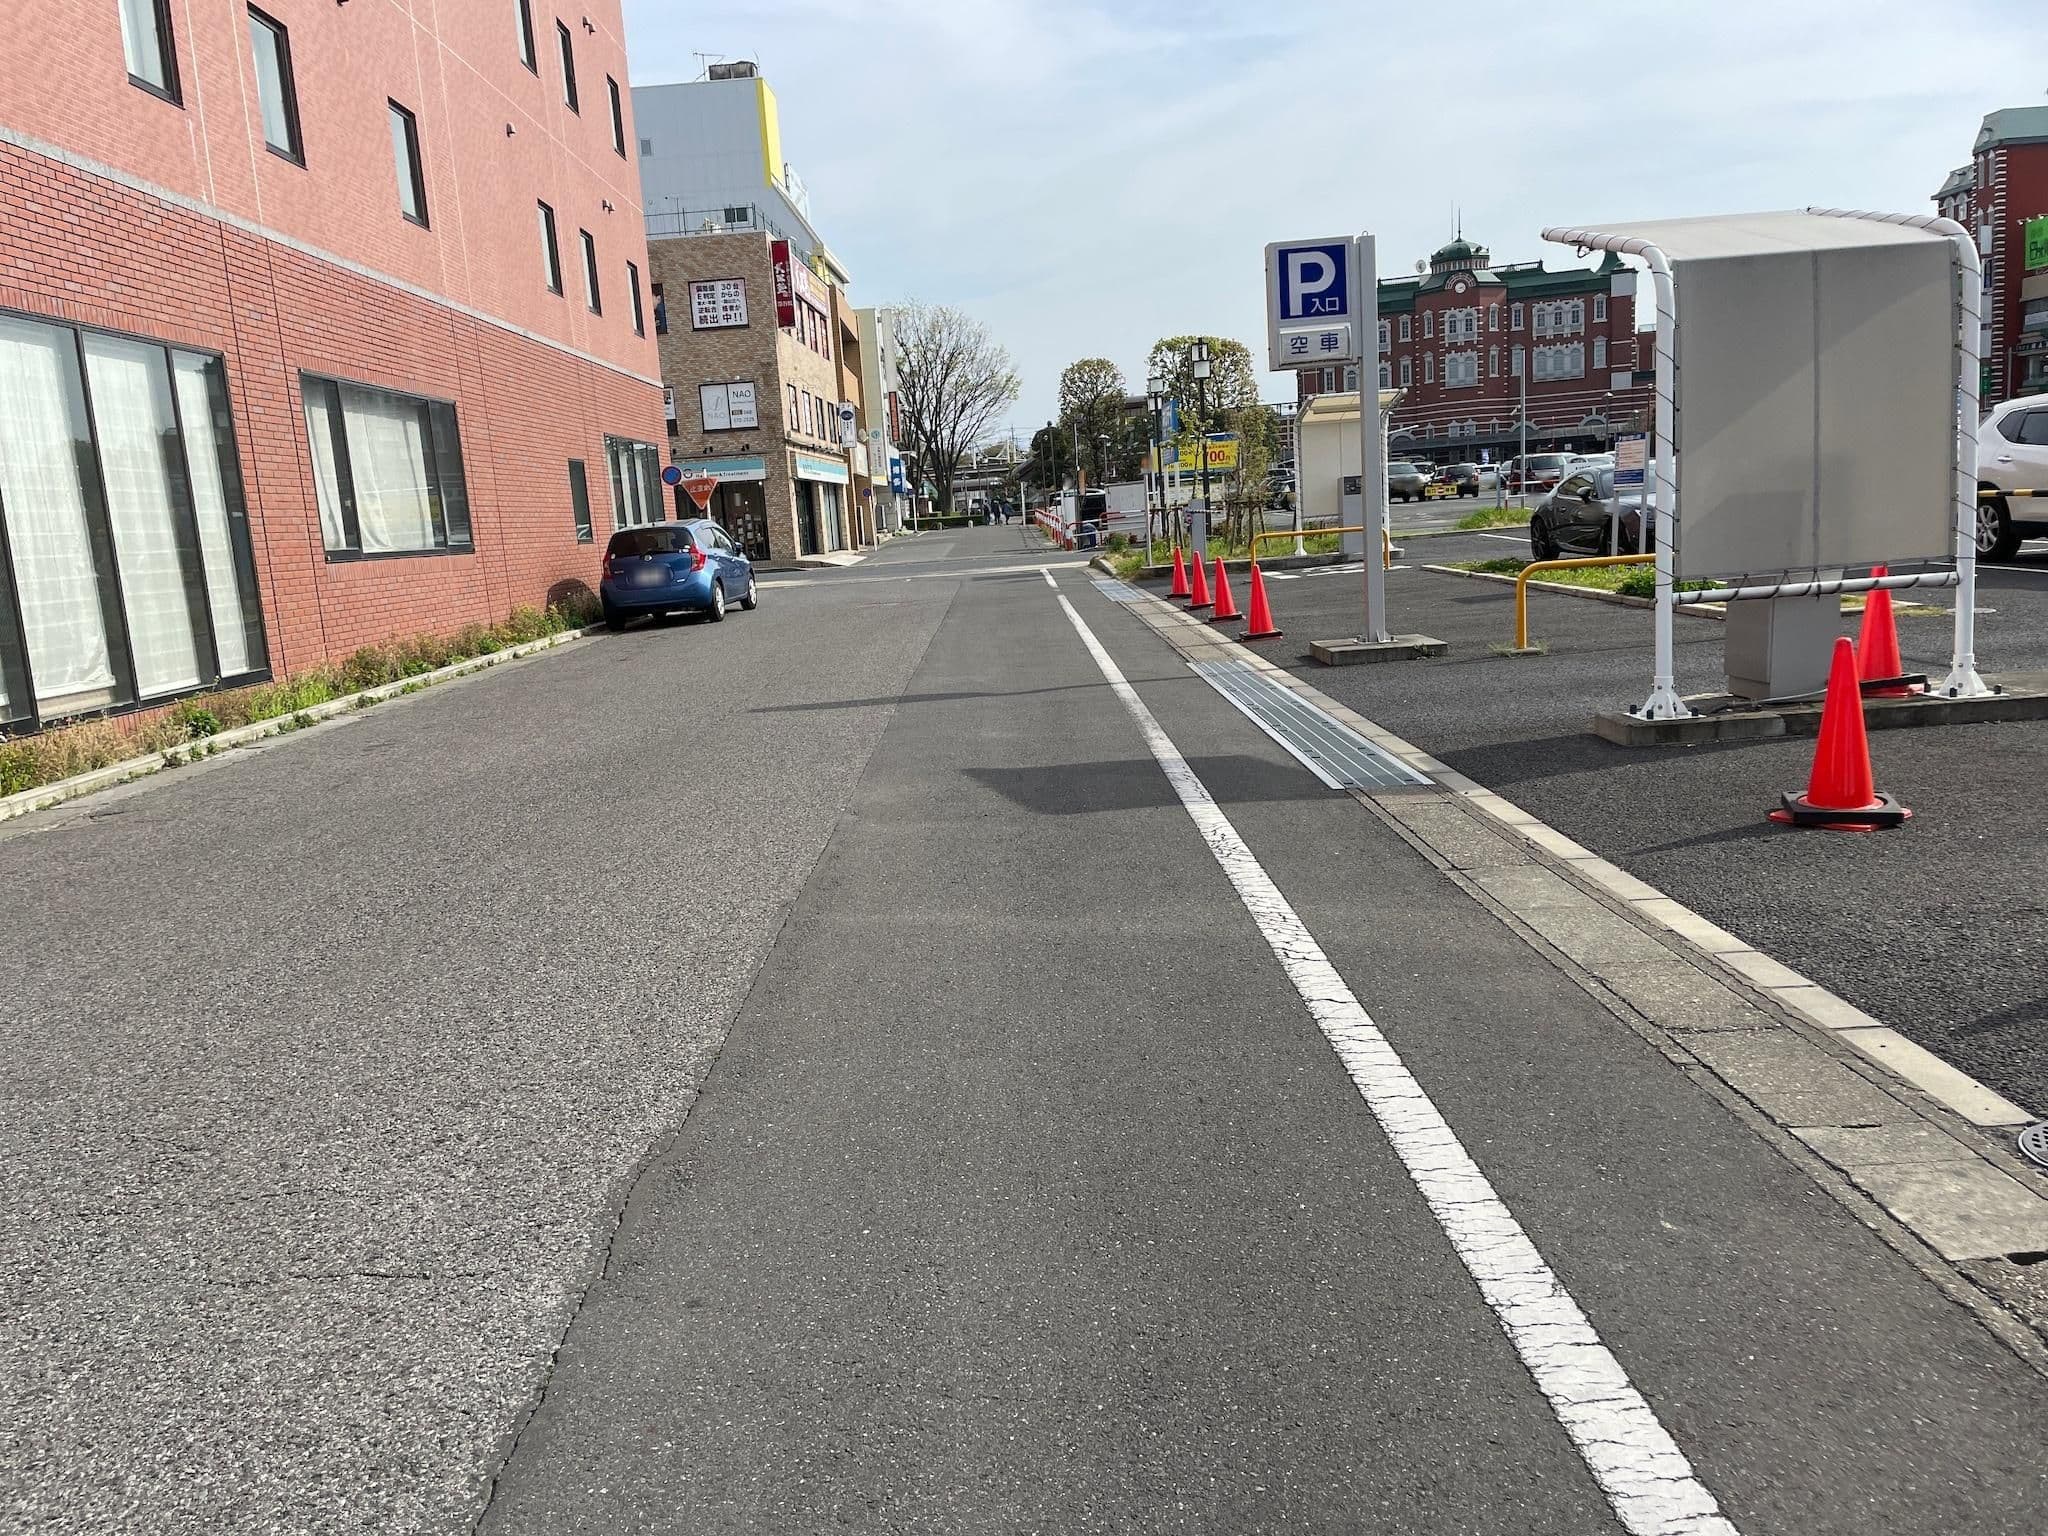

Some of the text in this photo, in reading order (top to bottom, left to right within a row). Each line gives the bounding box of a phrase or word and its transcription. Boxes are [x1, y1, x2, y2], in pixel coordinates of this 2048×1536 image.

[1287, 251, 1336, 316] P
[1311, 297, 1339, 313] 入口
[1290, 332, 1339, 355] 空車
[732, 389, 752, 398] NAO
